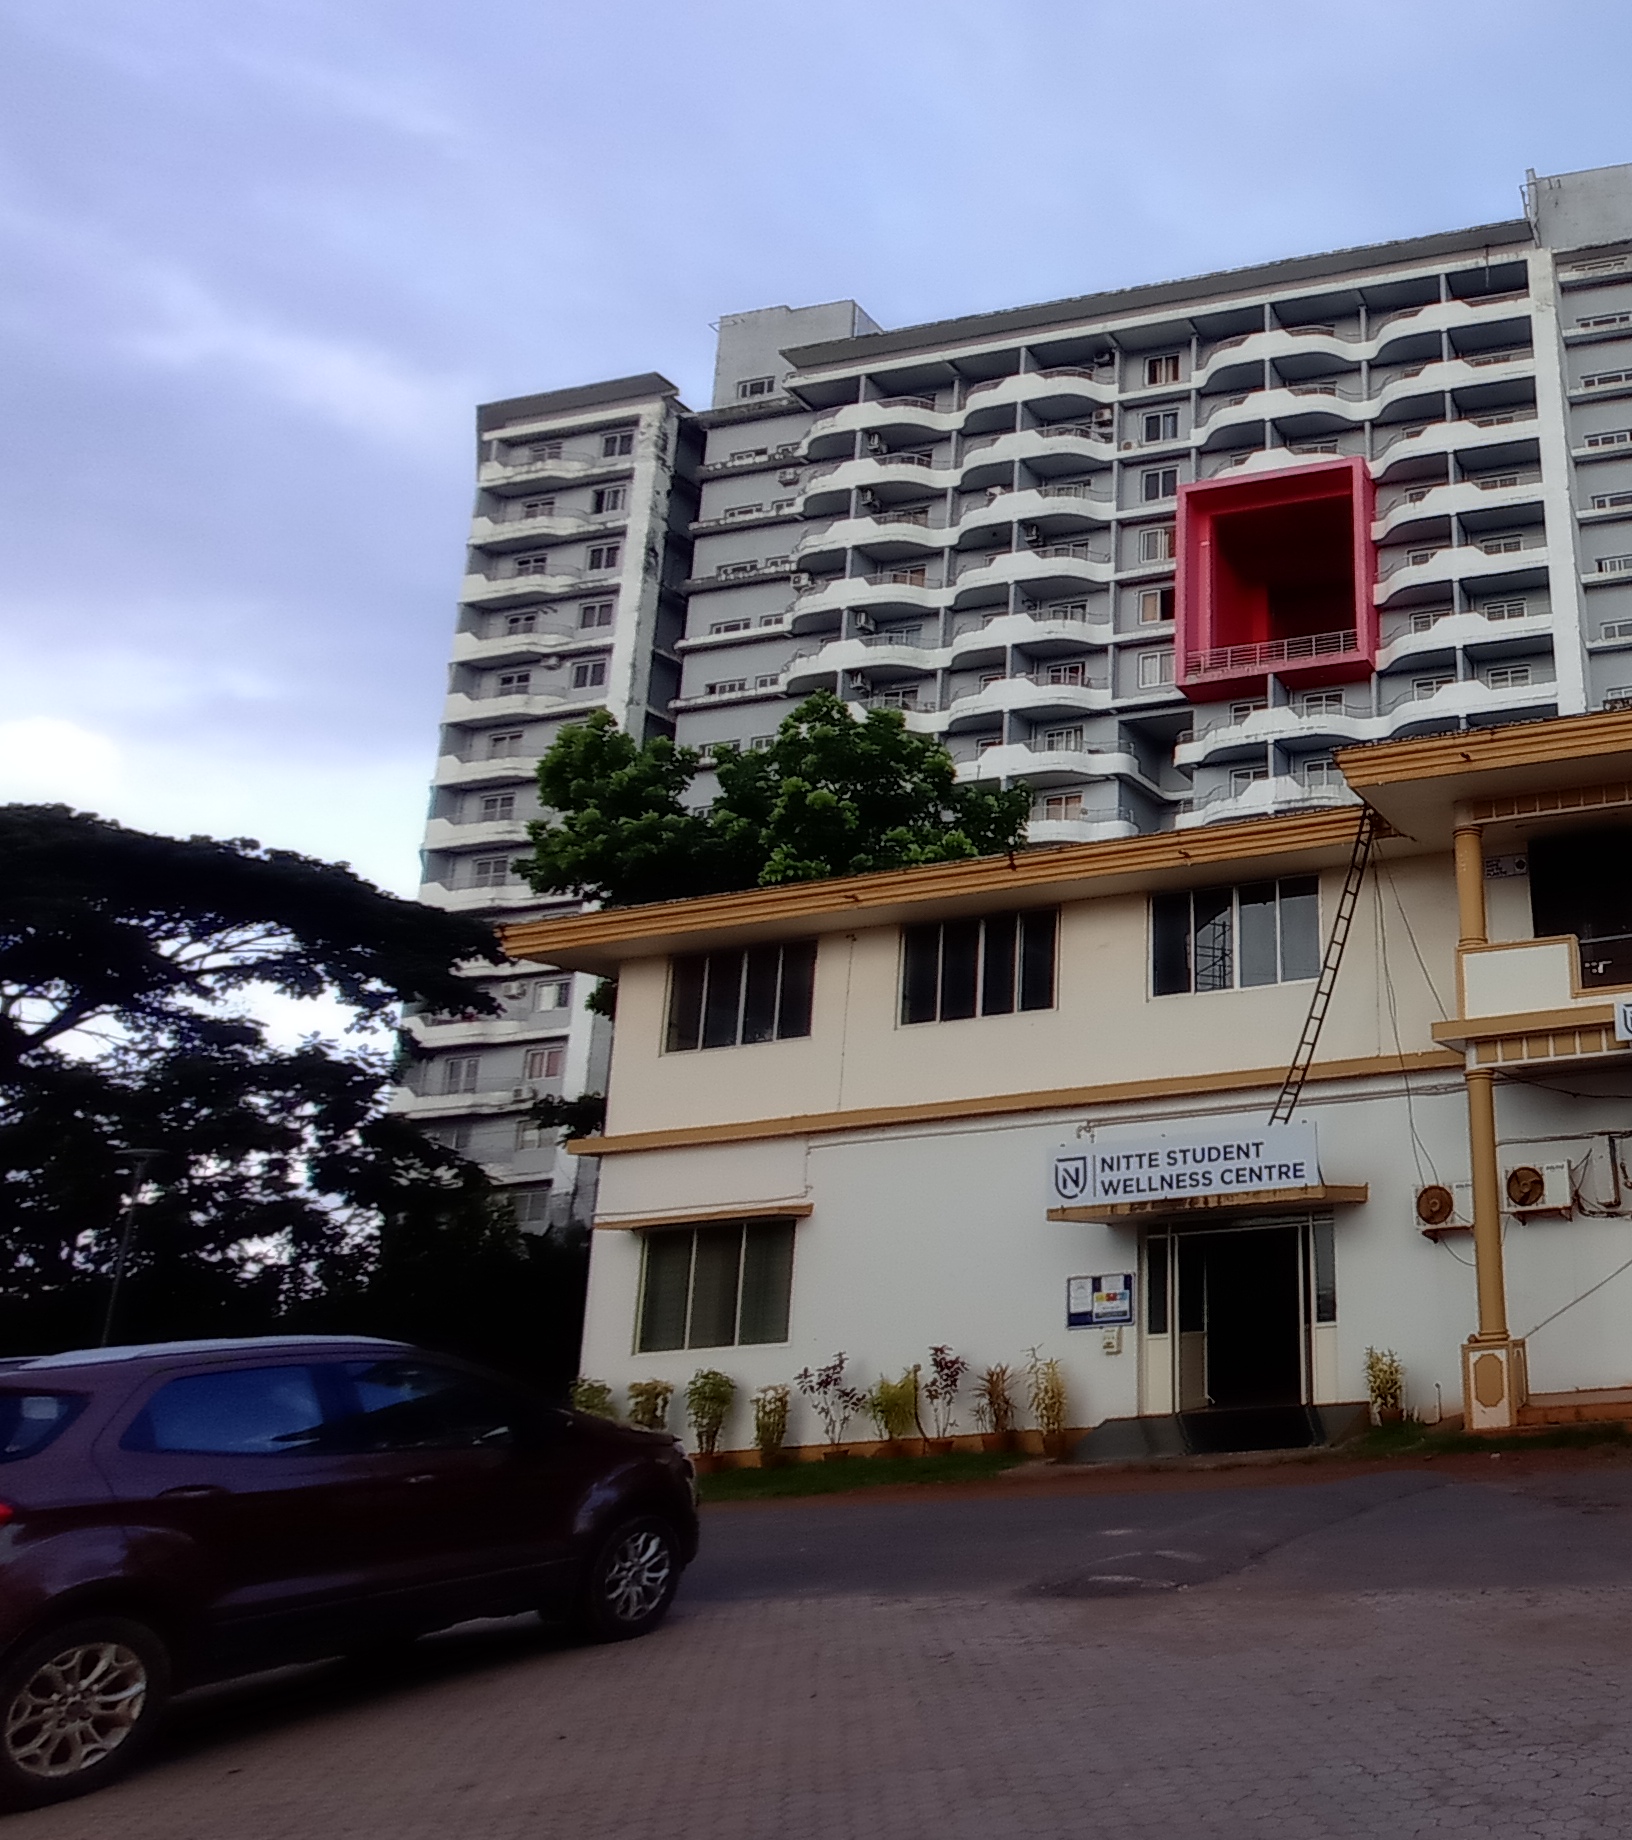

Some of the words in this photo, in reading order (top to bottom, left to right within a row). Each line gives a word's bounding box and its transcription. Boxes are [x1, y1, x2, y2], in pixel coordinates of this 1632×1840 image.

[1100, 1151, 1161, 1174] NITTE
[1166, 1141, 1265, 1167] STUDENT
[1100, 1170, 1214, 1197] WELLNESS
[1219, 1161, 1306, 1186] CENTRE
